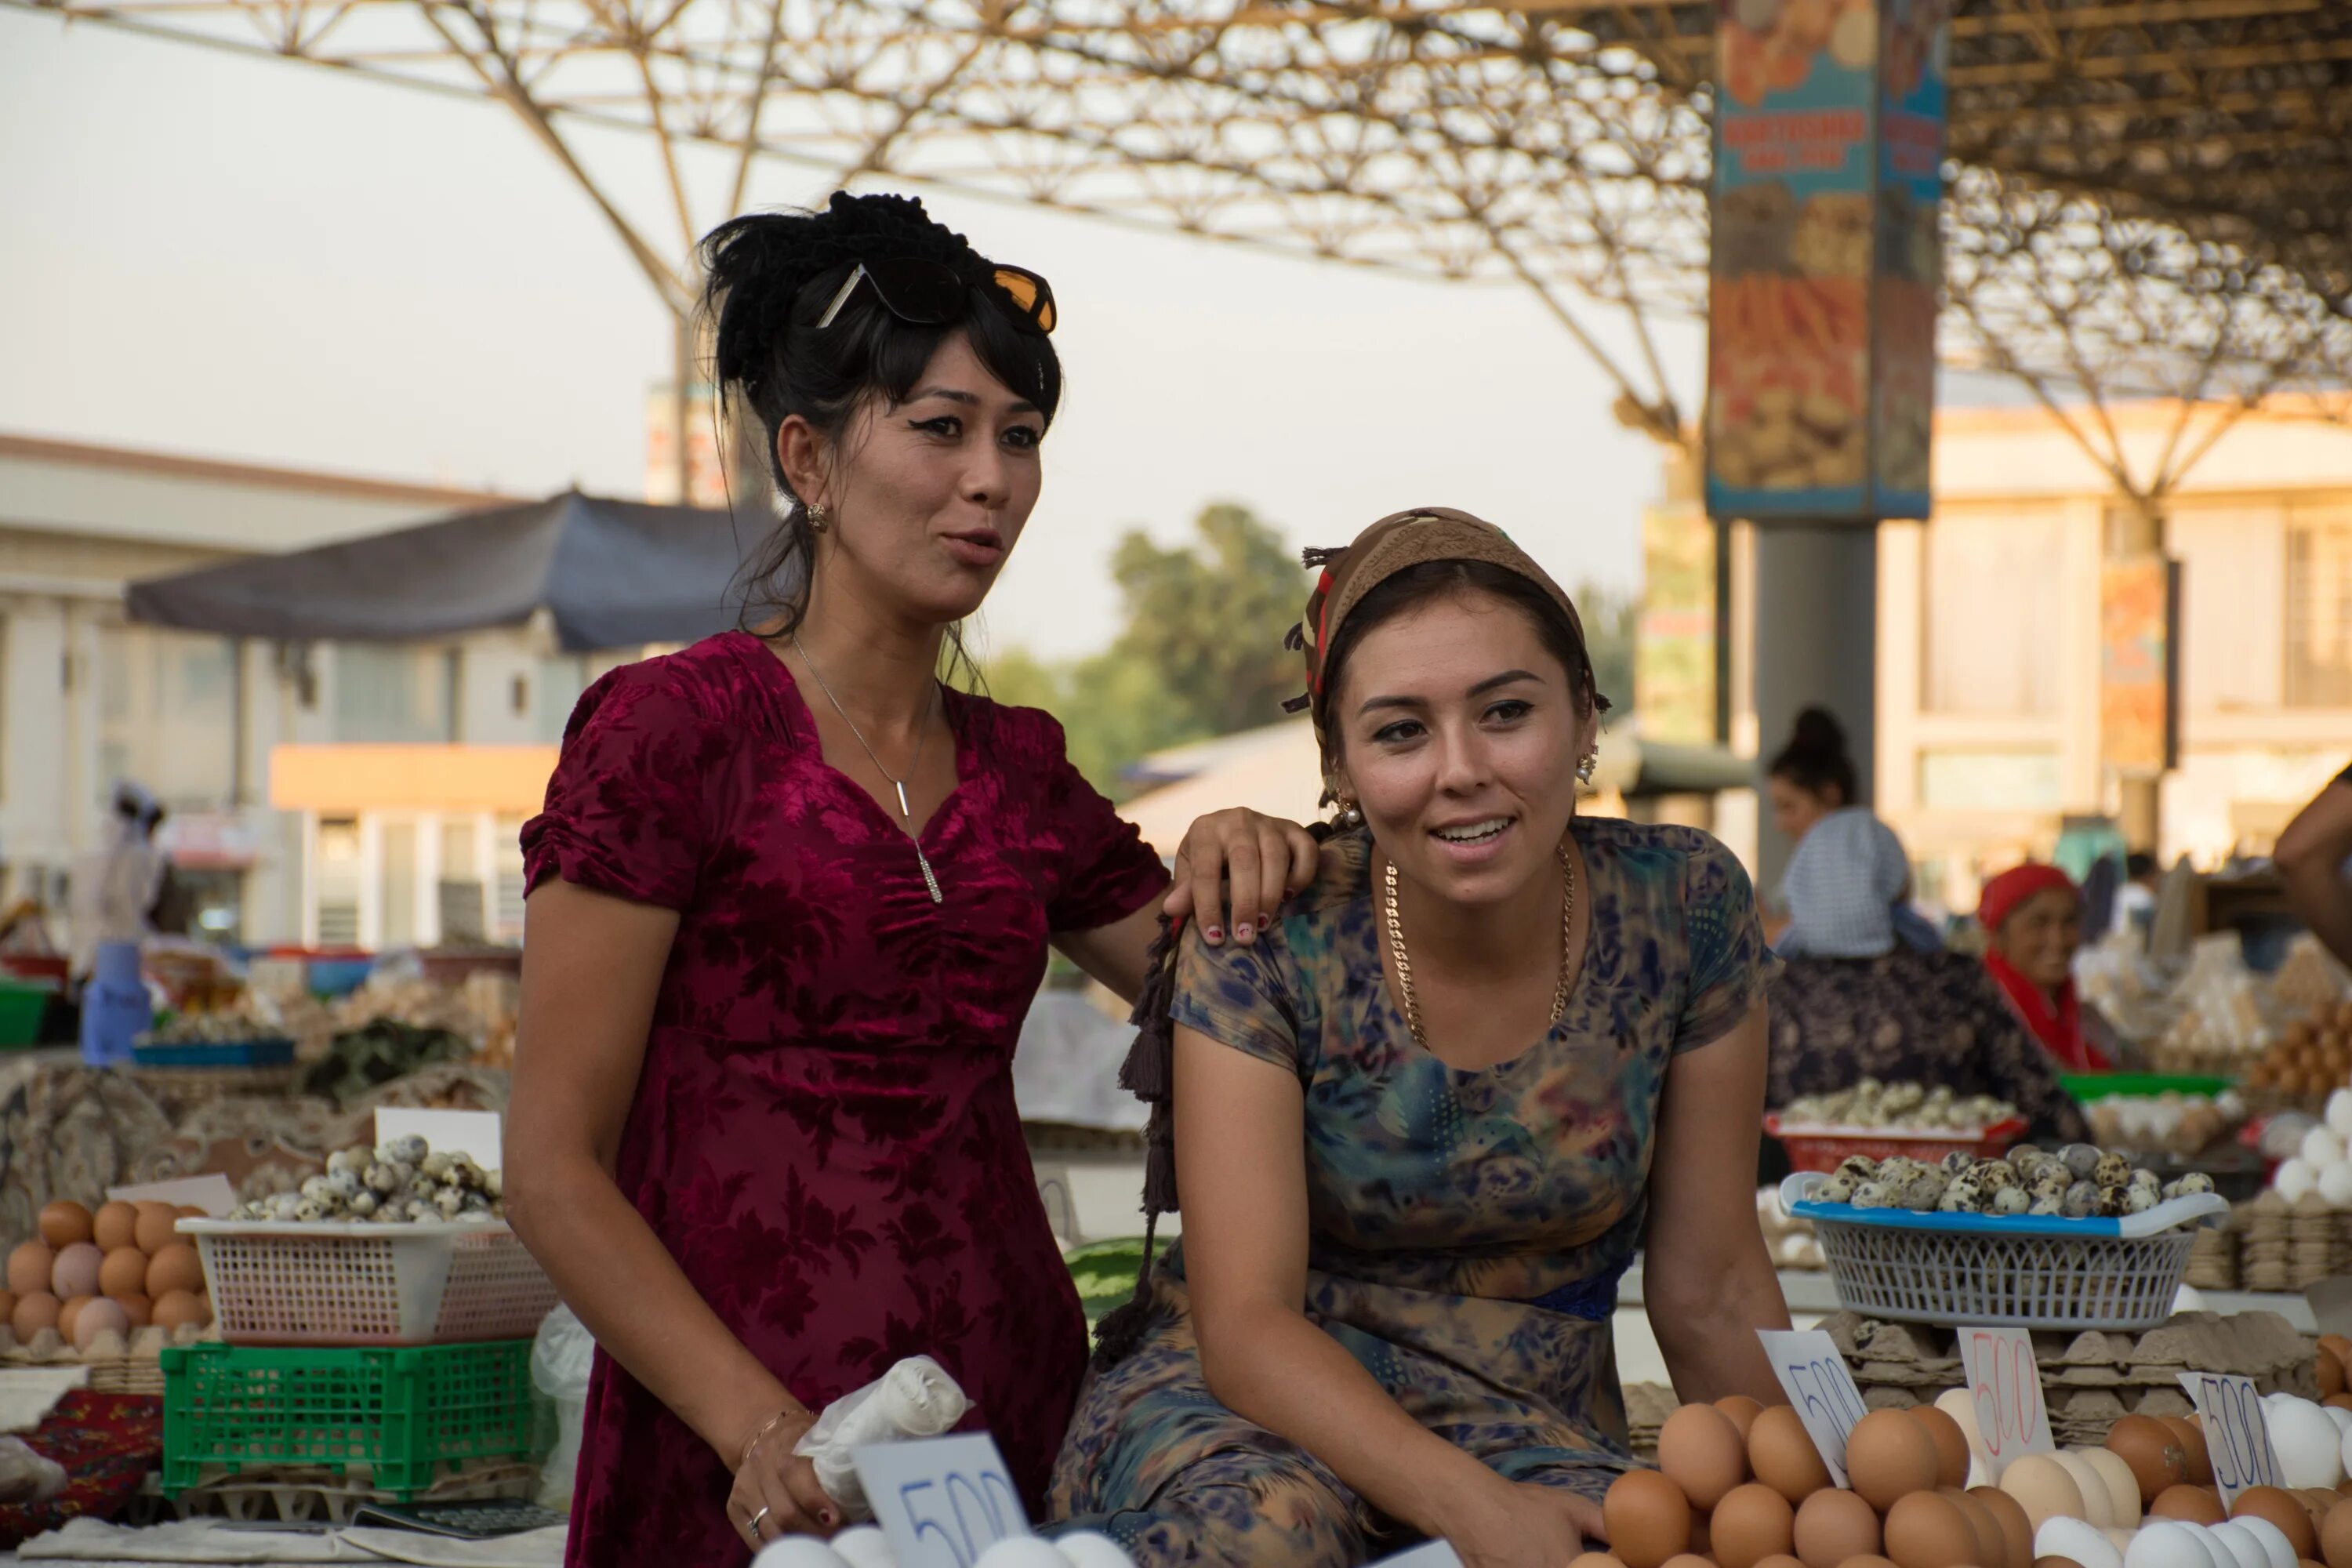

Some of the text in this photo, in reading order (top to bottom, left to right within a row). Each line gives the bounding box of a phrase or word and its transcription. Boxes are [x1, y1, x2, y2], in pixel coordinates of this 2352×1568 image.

[1973, 1333, 2037, 1457] 500
[2201, 1377, 2274, 1489] 500
[899, 1471, 1024, 1568] 500
